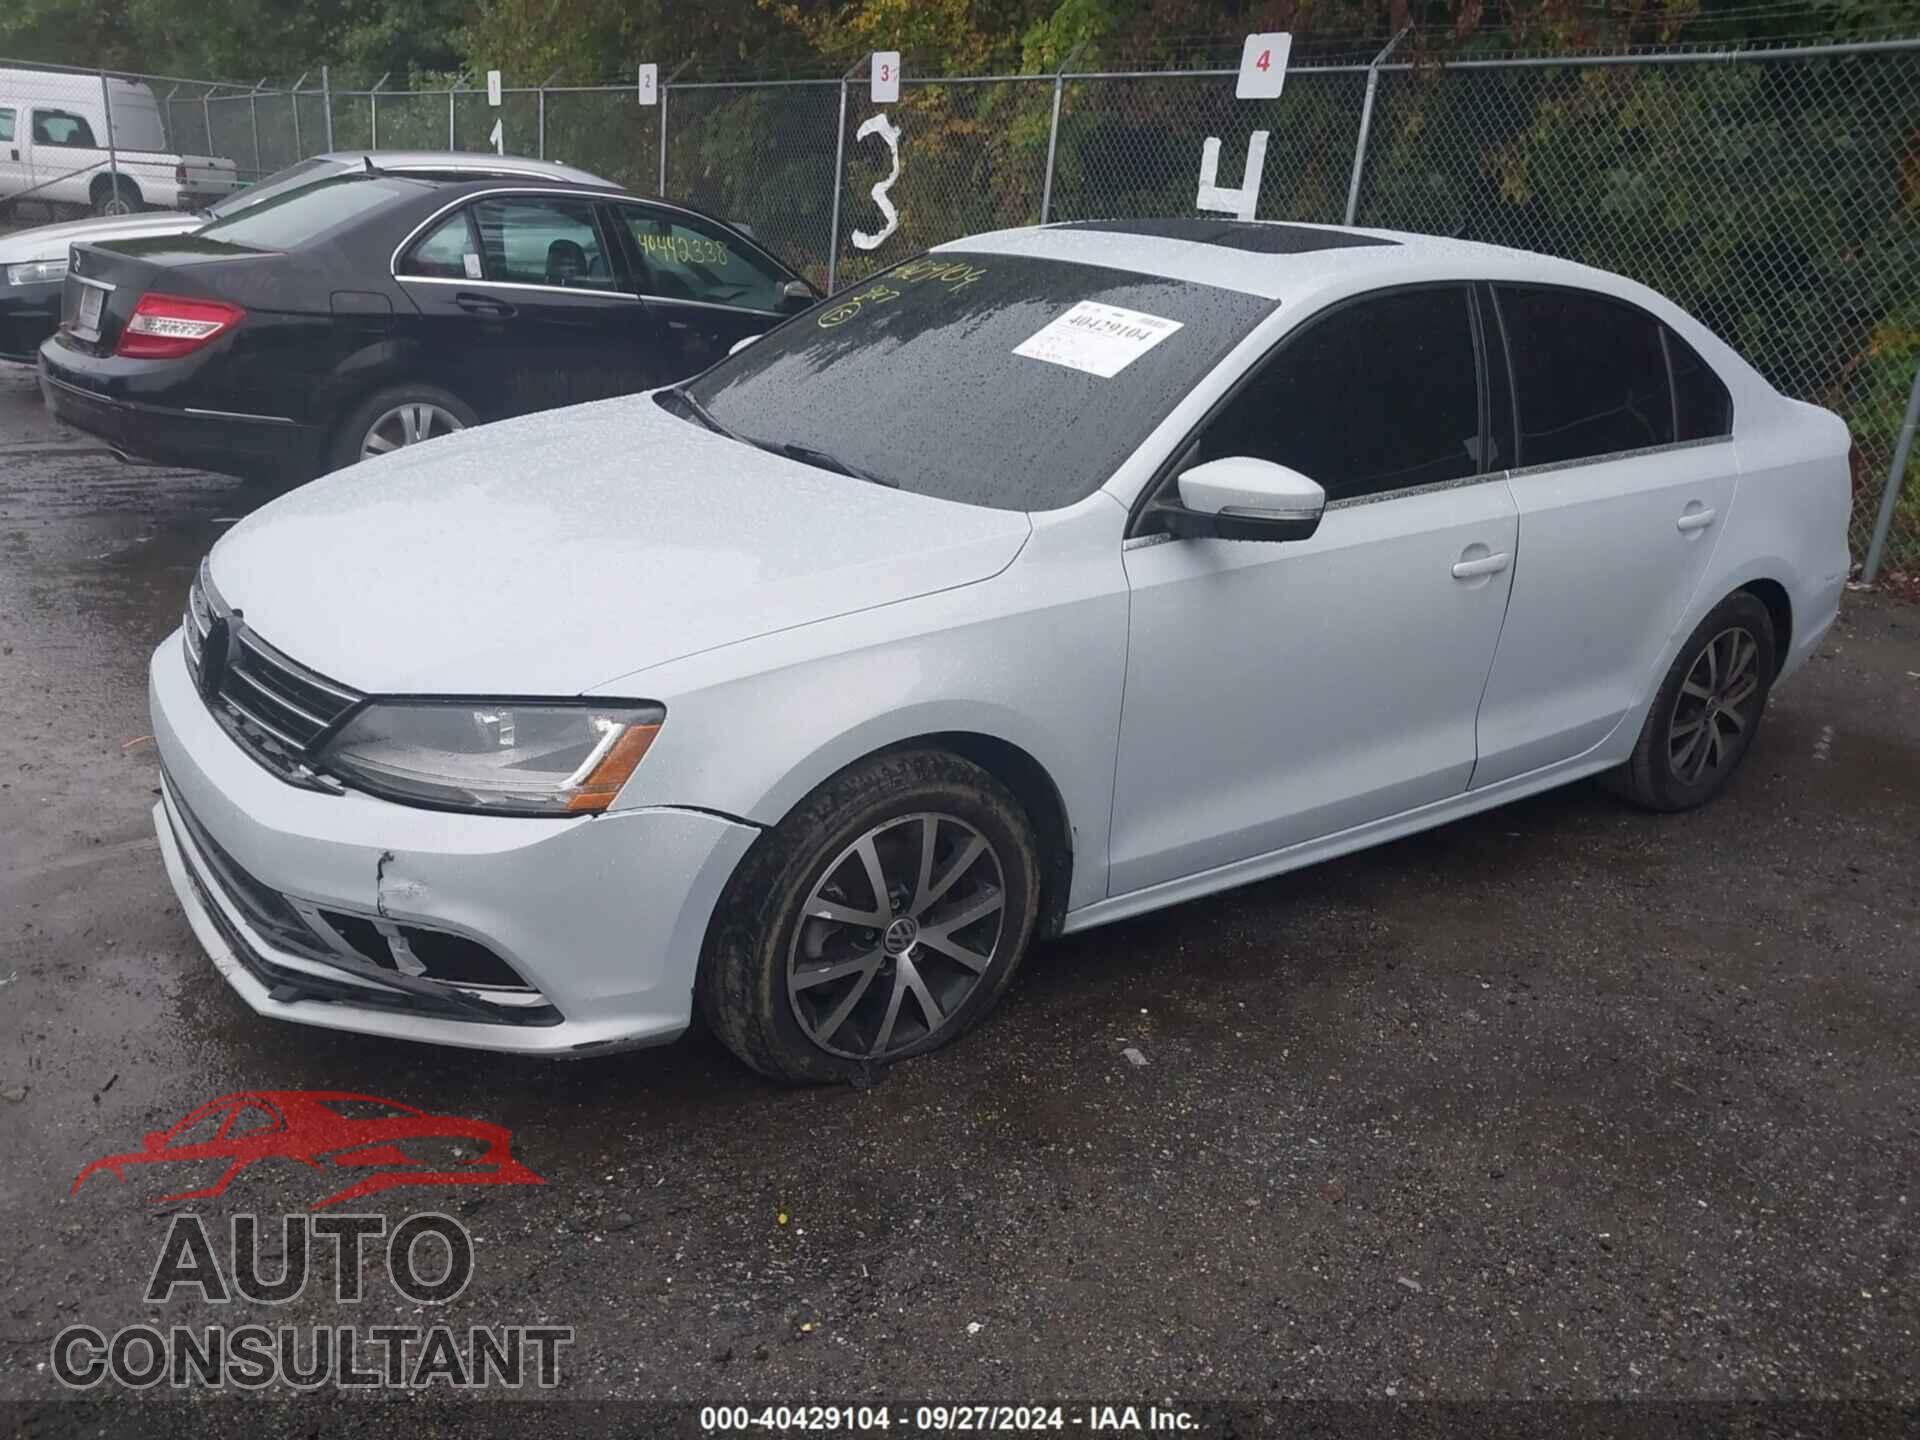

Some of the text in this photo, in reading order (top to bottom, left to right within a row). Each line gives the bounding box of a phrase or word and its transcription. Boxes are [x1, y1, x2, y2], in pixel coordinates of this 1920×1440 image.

[881, 64, 890, 82] 3
[1256, 50, 1271, 72] 4
[851, 113, 901, 250] 3
[1197, 130, 1270, 222] 4
[1068, 314, 1153, 342] 40429104
